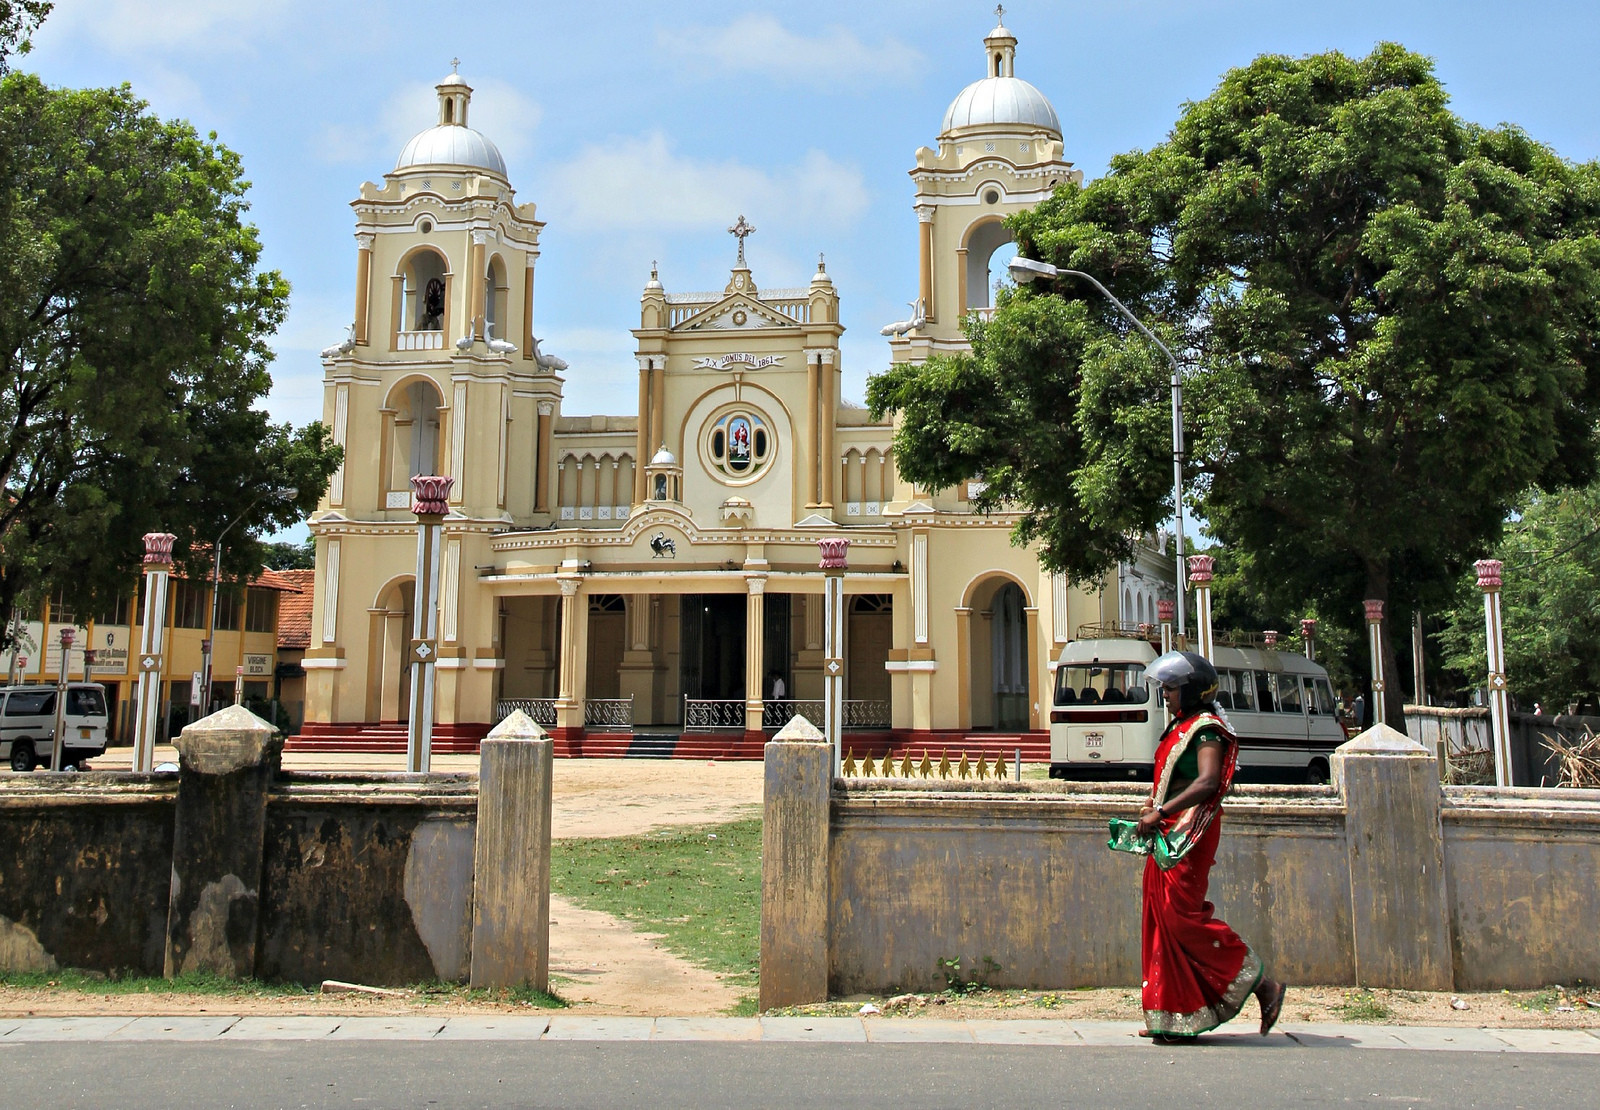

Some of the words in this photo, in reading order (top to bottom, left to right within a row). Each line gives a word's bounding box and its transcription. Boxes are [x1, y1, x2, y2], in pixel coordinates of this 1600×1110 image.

[721, 353, 742, 364] DOMUS
[744, 354, 755, 364] DEI
[758, 356, 773, 367] 1861
[247, 656, 267, 665] VIRGINE
[250, 665, 264, 673] BLOCK
